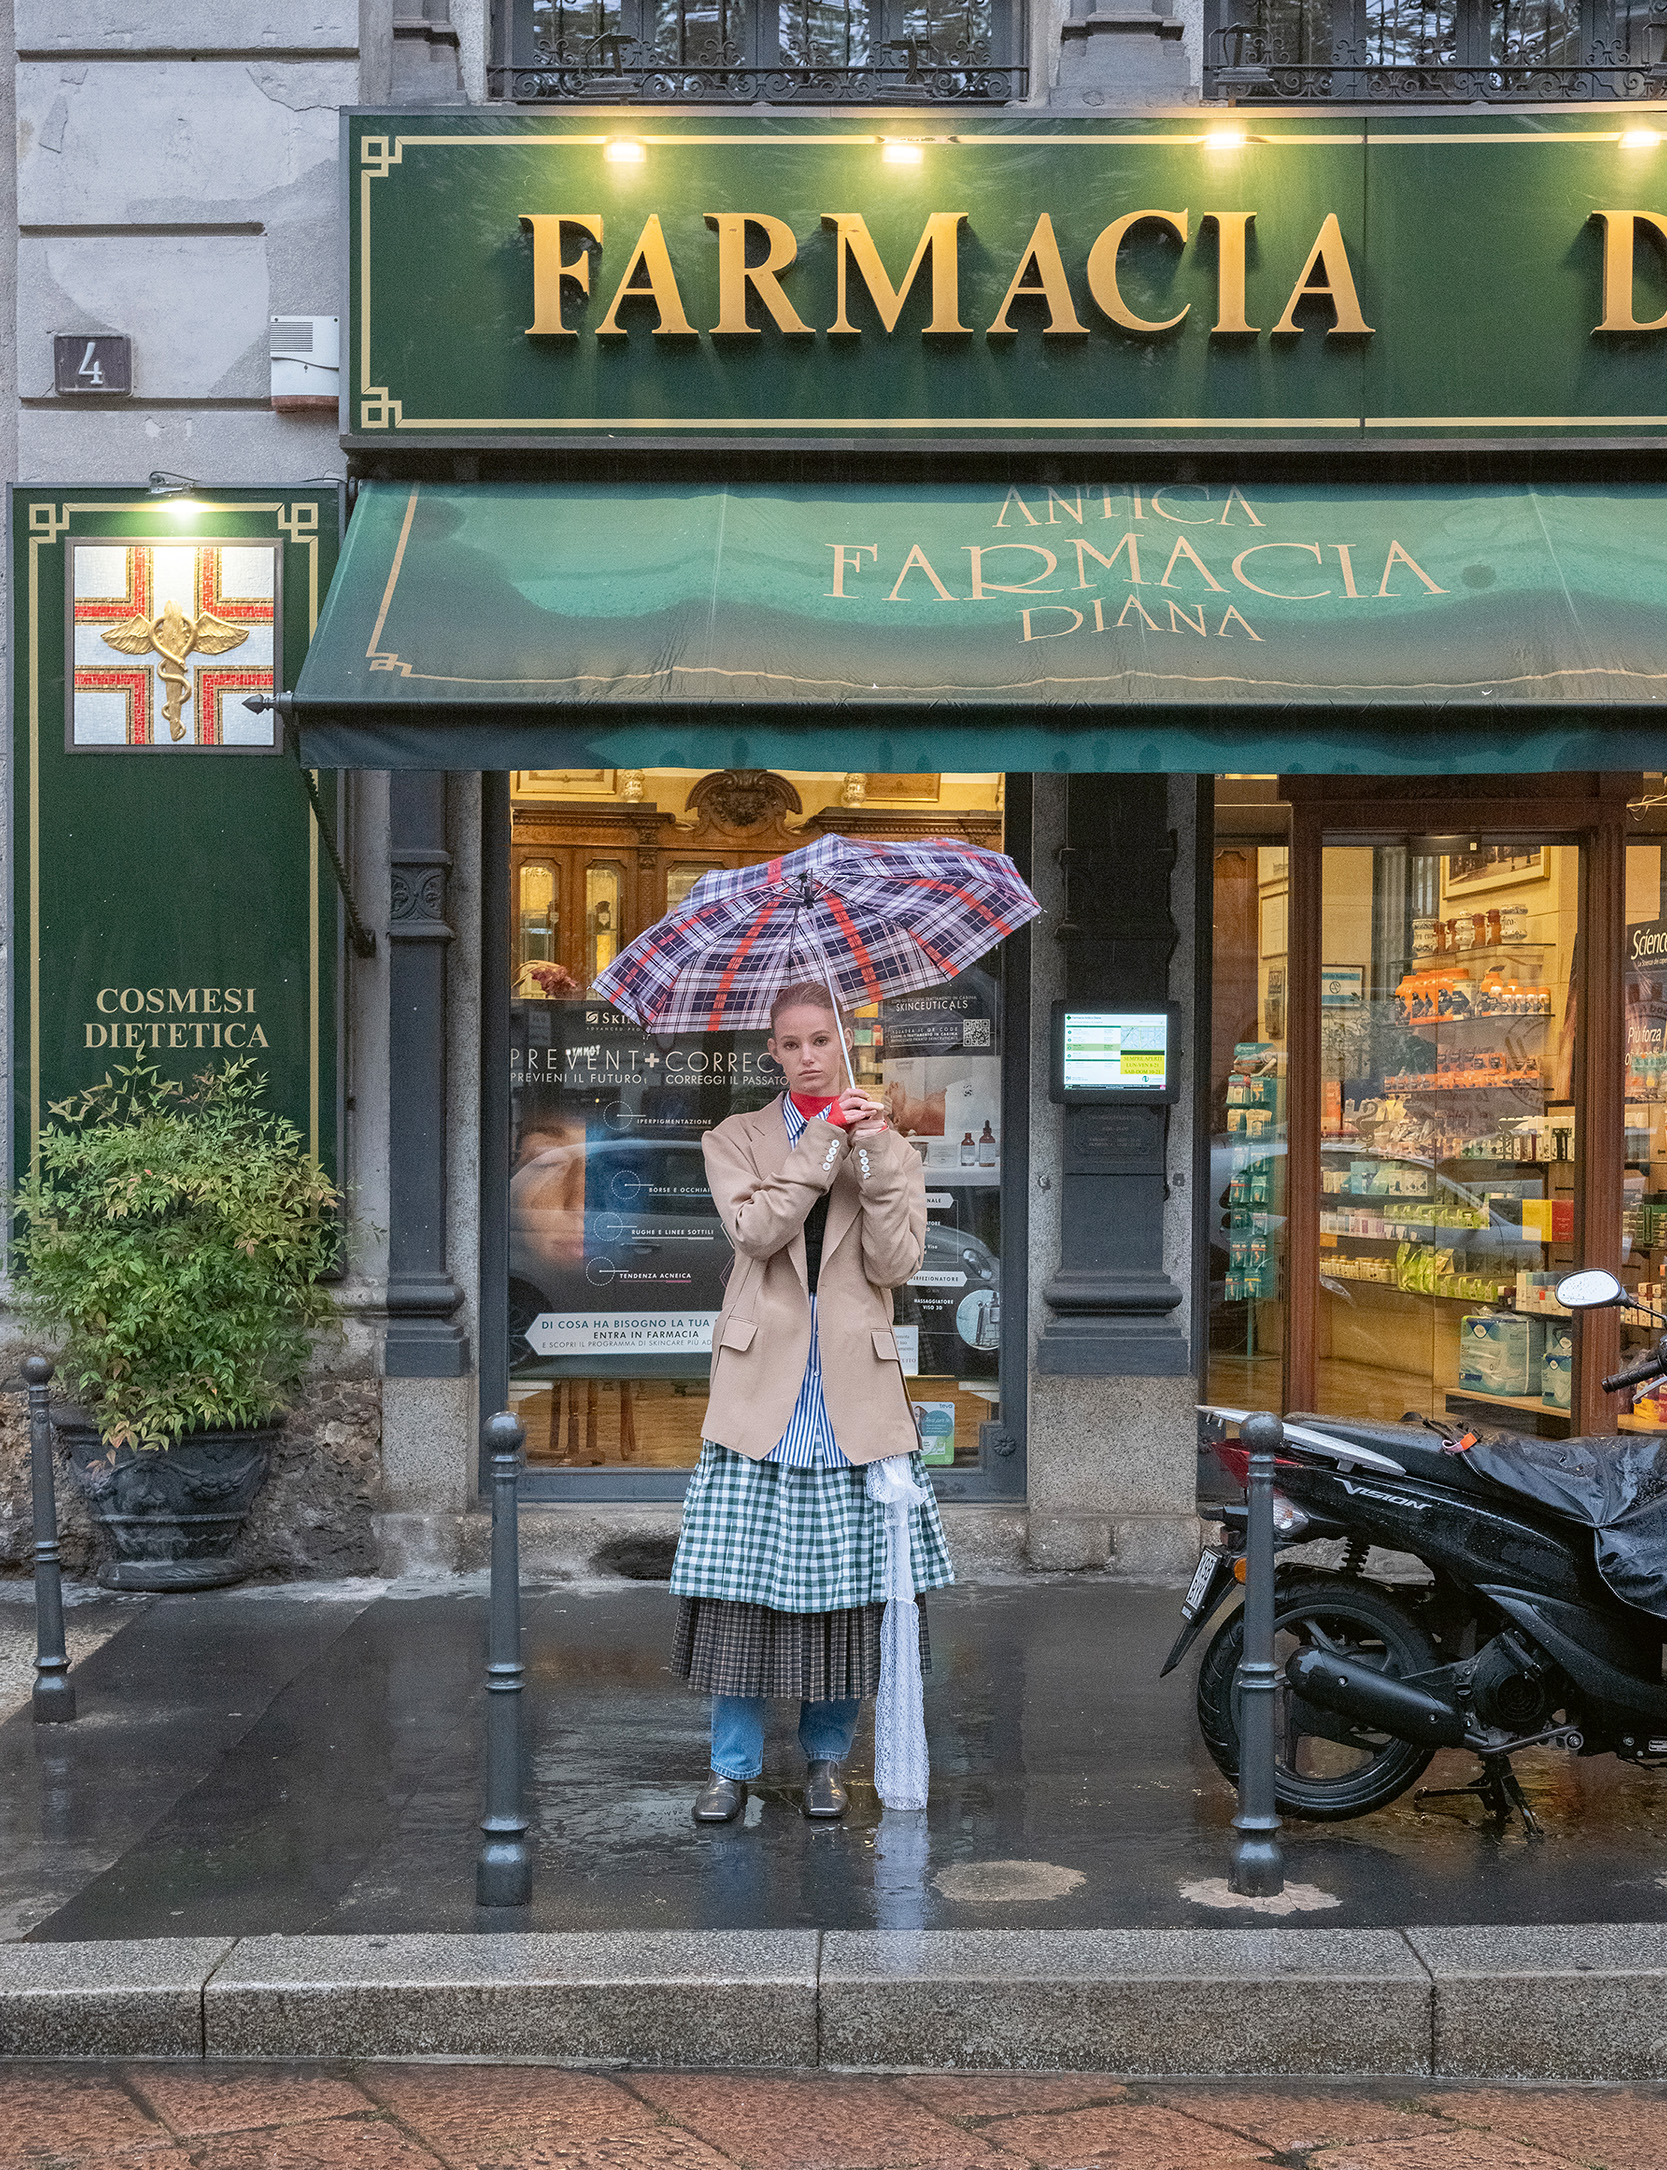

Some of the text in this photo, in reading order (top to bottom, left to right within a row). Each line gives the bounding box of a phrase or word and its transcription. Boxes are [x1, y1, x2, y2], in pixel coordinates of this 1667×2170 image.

[517, 207, 1376, 336] FARMACIA
[79, 341, 103, 385] 4
[992, 484, 1267, 528] ANTICA
[823, 533, 1452, 602] FARMACIA
[1018, 594, 1266, 643] DIANA
[96, 988, 257, 1014] COSMESI
[896, 1000, 969, 1012] SKINCEUTICALS
[83, 1023, 270, 1049] DIETETICA
[1641, 1025, 1662, 1043] forza
[510, 1047, 639, 1072] PREVENT
[510, 1073, 642, 1084] PREVIENI IL FUTURO
[666, 1075, 726, 1085] CORREGGI
[729, 1075, 738, 1085] IL
[541, 1319, 709, 1329] DI COSA HA BISOGNO LA TUA
[594, 1330, 699, 1339] ENTRA IN FARMACIA
